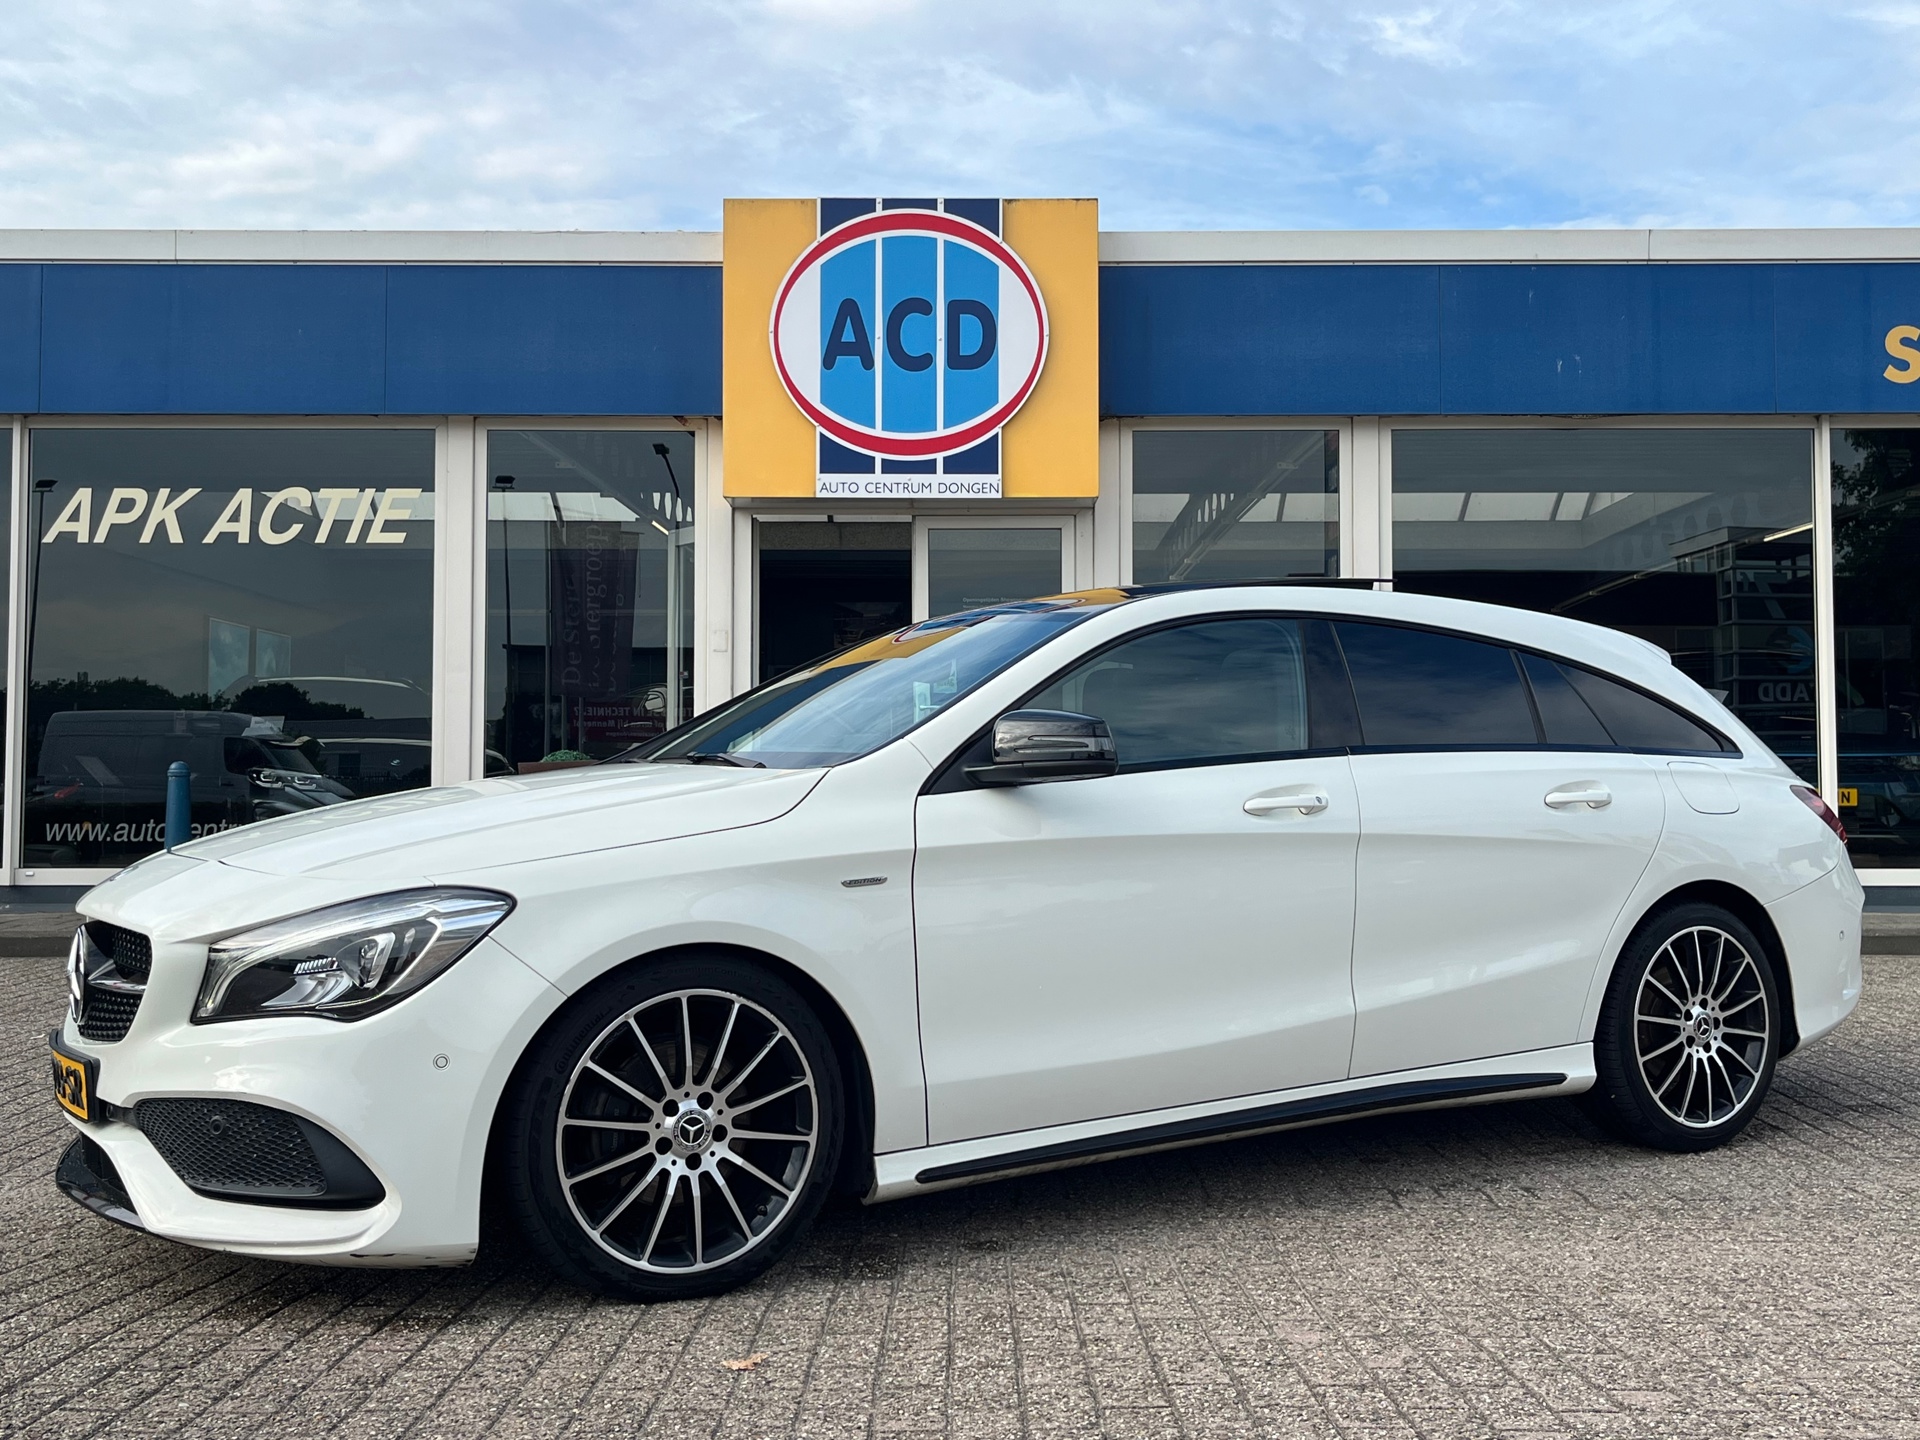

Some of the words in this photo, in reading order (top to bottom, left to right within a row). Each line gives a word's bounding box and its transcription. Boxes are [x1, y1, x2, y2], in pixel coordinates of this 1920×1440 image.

[822, 297, 997, 372] ACD
[42, 487, 202, 544] APK
[202, 487, 422, 545] ACTIE
[820, 481, 859, 494] AUTO
[865, 481, 932, 494] CENTRUM
[938, 481, 1000, 494] DONGEN
